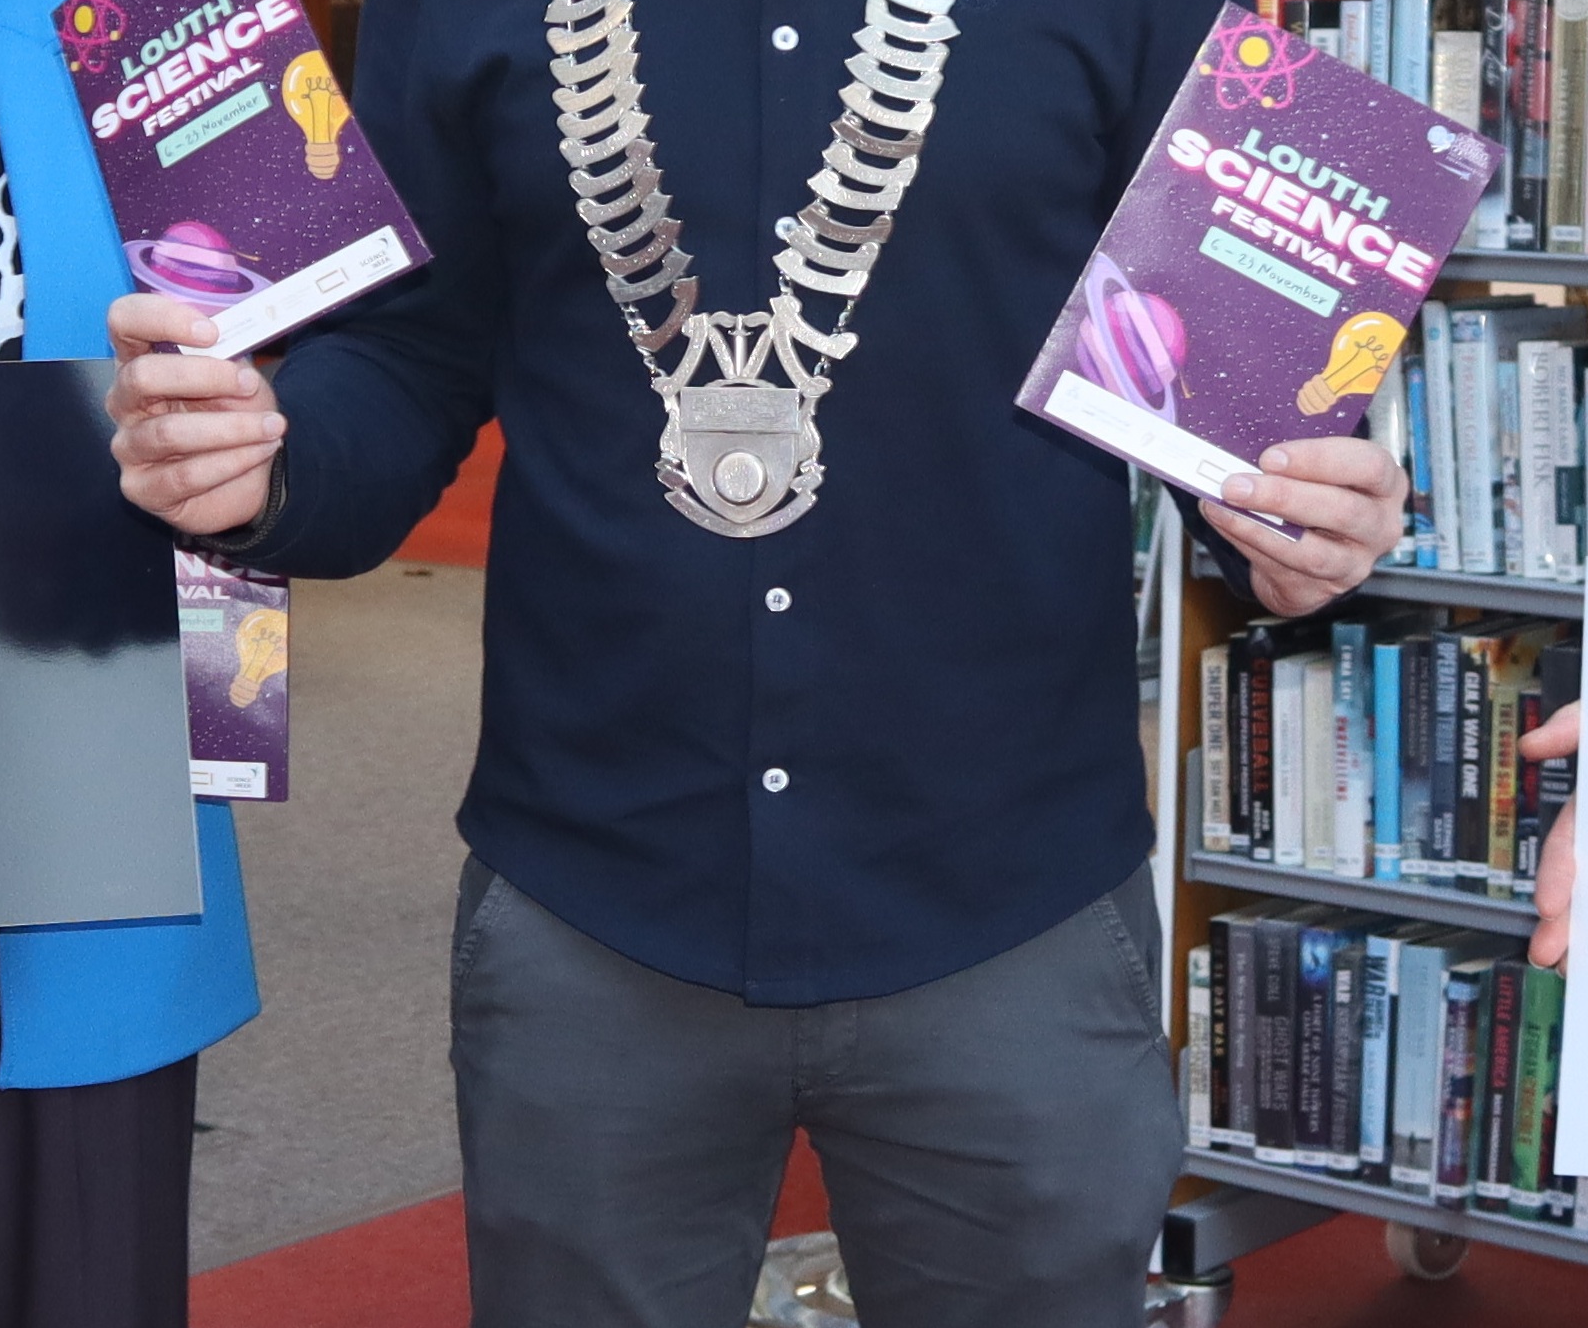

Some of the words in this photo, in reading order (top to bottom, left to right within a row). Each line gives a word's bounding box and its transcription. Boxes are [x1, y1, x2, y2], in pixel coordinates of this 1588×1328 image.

[142, 57, 263, 138] FESTIVAL
[201, 95, 259, 135] November
[1239, 128, 1390, 221] LOUTH
[1166, 128, 1438, 291] SCIENCE
[1211, 195, 1362, 285] FESTIVAL
[1258, 264, 1328, 305] November
[1531, 352, 1552, 436] ROBERT
[1530, 443, 1552, 490] FISK
[1340, 644, 1353, 677] EMMA
[1436, 642, 1457, 713] OPERATION
[1208, 665, 1223, 720] SNIPER
[1239, 672, 1249, 716] STANDARD
[1340, 679, 1353, 701] SKY
[1463, 670, 1480, 714] GULF
[1208, 723, 1222, 752] ONE
[1252, 658, 1270, 794] CURVEBALL
[1462, 718, 1480, 759] WAR
[1335, 715, 1350, 801] UNRAVELLING
[1239, 766, 1249, 816] PROCEDURE
[1461, 763, 1478, 799] ONE
[1335, 969, 1351, 1004] WAR
[1365, 955, 1387, 999] WAR
[1495, 975, 1515, 1021] LITTLE
[1213, 985, 1224, 1017] DAY
[1311, 1003, 1323, 1032] FORT
[1213, 1022, 1224, 1057] WAR
[1272, 1015, 1290, 1064] GHOST
[1493, 1024, 1513, 1089] AMERICA
[1272, 1069, 1290, 1111] WARS
